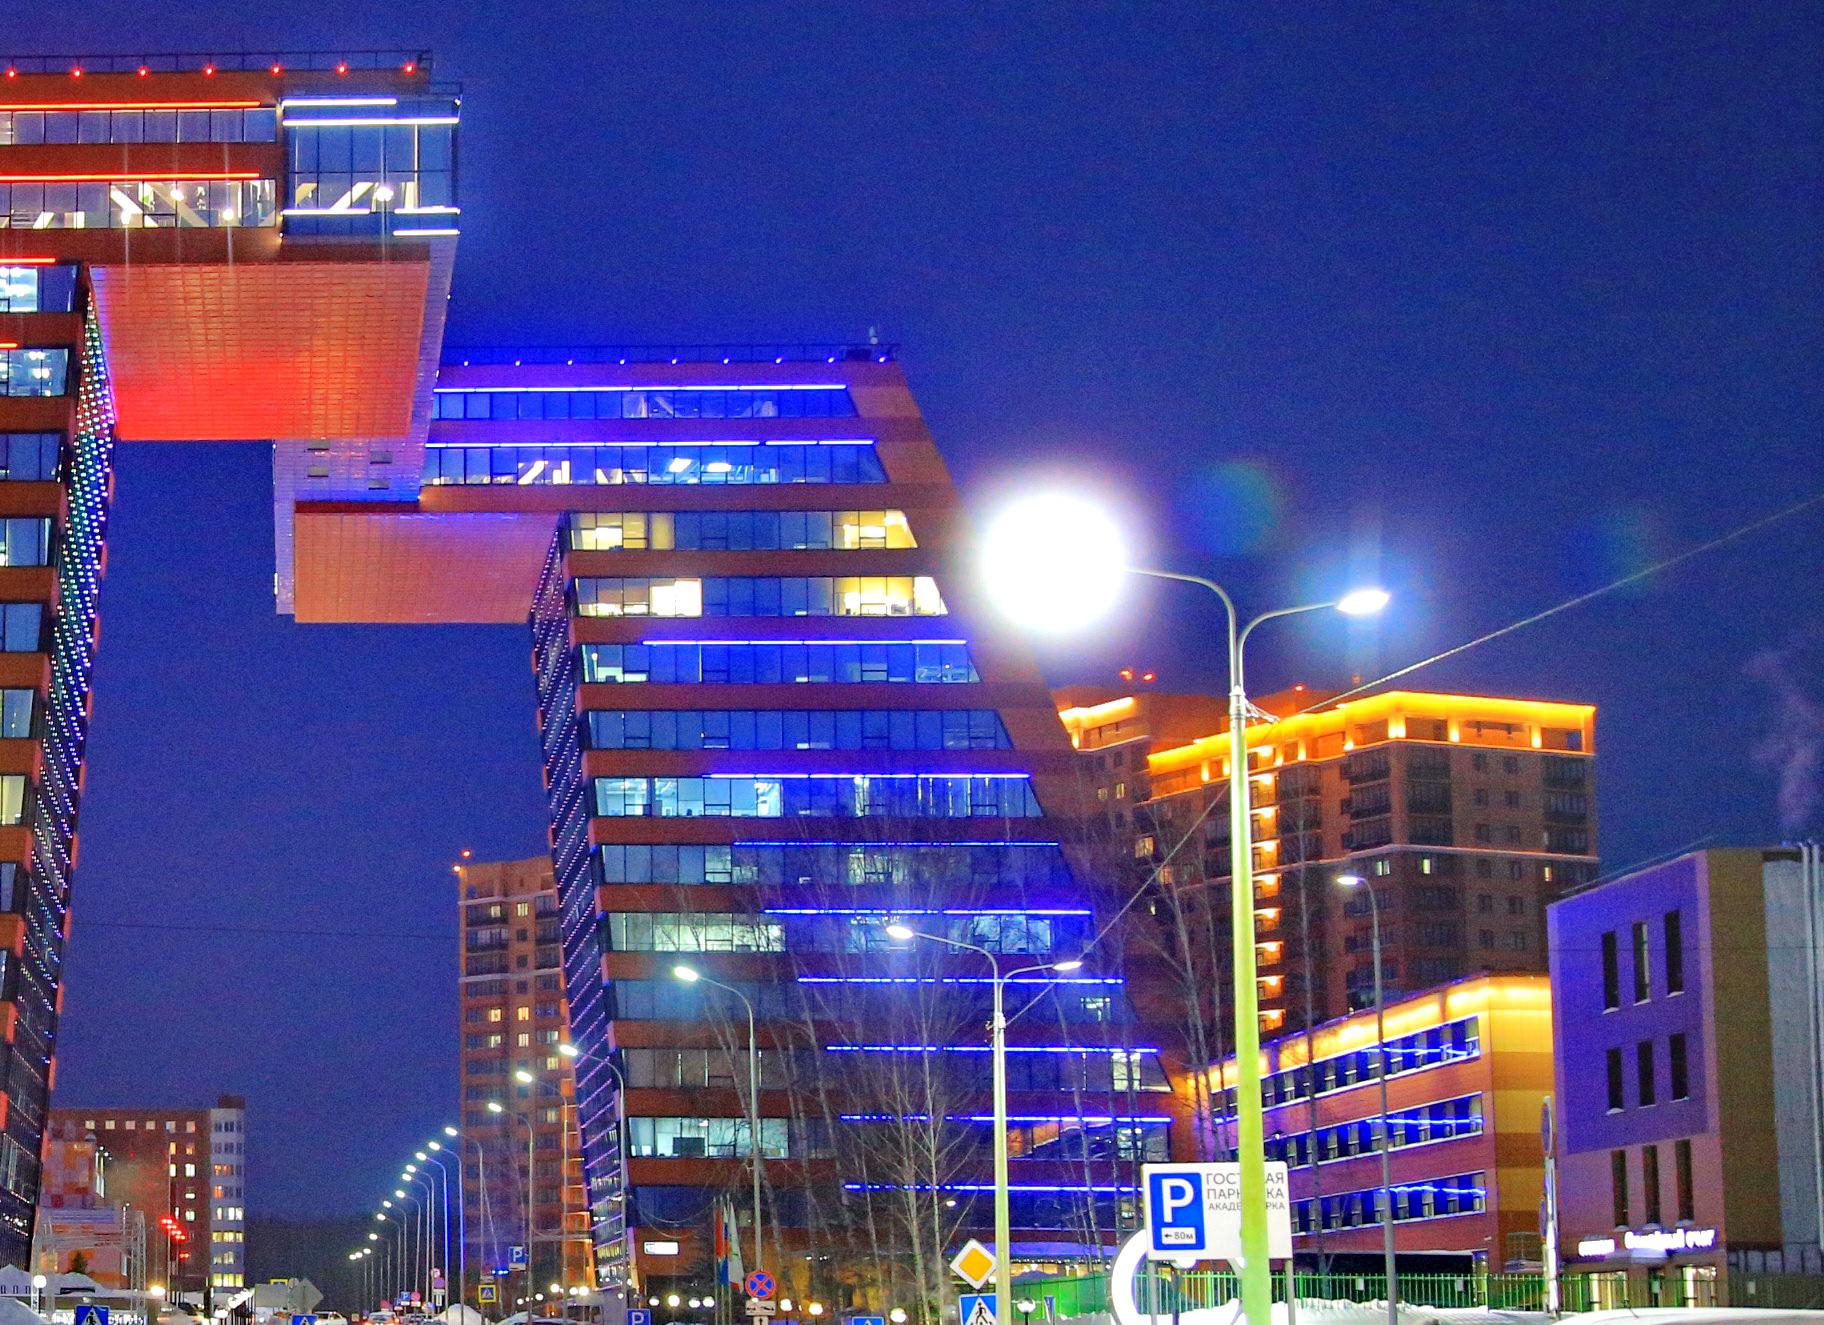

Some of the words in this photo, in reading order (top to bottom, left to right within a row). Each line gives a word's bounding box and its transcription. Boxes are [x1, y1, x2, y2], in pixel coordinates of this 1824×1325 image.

[1206, 1172, 1285, 1185] ГОСАЯ
[1161, 1178, 1195, 1223] P
[1207, 1188, 1285, 1200] ПАРКА
[1208, 1202, 1286, 1211] АКАДЕРКА
[513, 1248, 523, 1262] P
[631, 1312, 645, 1325] P
